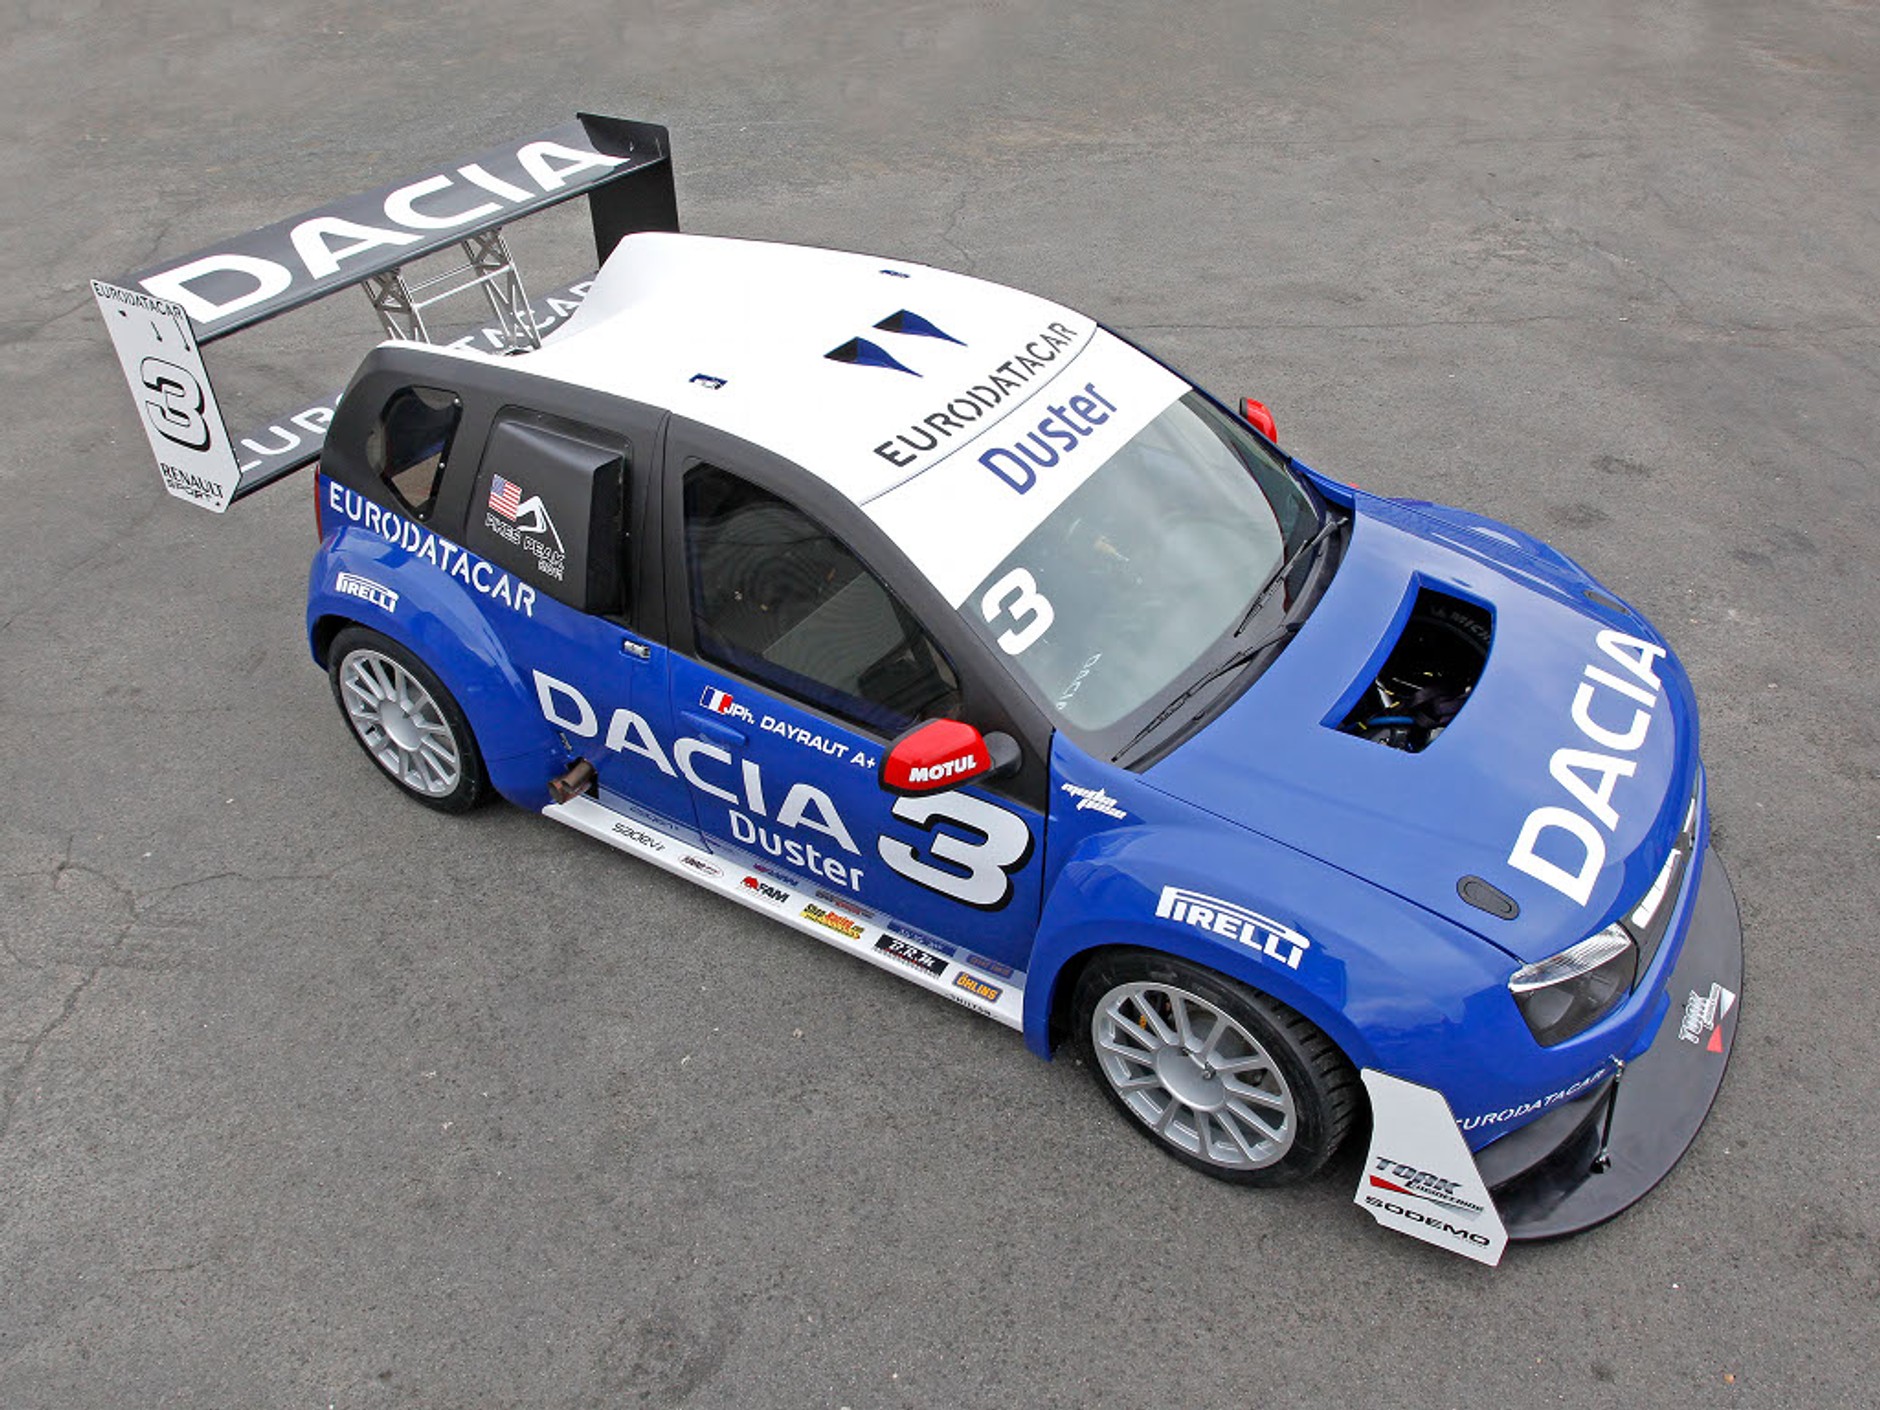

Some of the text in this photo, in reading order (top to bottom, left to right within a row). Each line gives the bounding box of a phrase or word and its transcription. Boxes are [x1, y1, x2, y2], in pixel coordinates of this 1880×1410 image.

[139, 140, 631, 324] DACIA
[93, 281, 185, 320] EURODATACAR
[140, 356, 211, 452] 3
[873, 321, 1078, 468] EURODATACAR
[160, 462, 224, 499] RENAULT
[977, 381, 1117, 495] Duster
[329, 481, 536, 617] EURODATACAR
[335, 571, 399, 613] PIRELLI
[981, 566, 1055, 656] 3
[533, 669, 860, 856] DACIA
[724, 702, 876, 768] JPh. DAYRAUT A+
[909, 754, 977, 782] MOTUL
[1507, 628, 1666, 907] DACIA
[730, 808, 864, 892] Duster
[877, 790, 1034, 912] 3
[760, 883, 790, 903] FAM
[1155, 885, 1311, 970] PIRELLI
[1376, 1156, 1462, 1195] TORK
[1364, 1195, 1490, 1246] SODEMO
